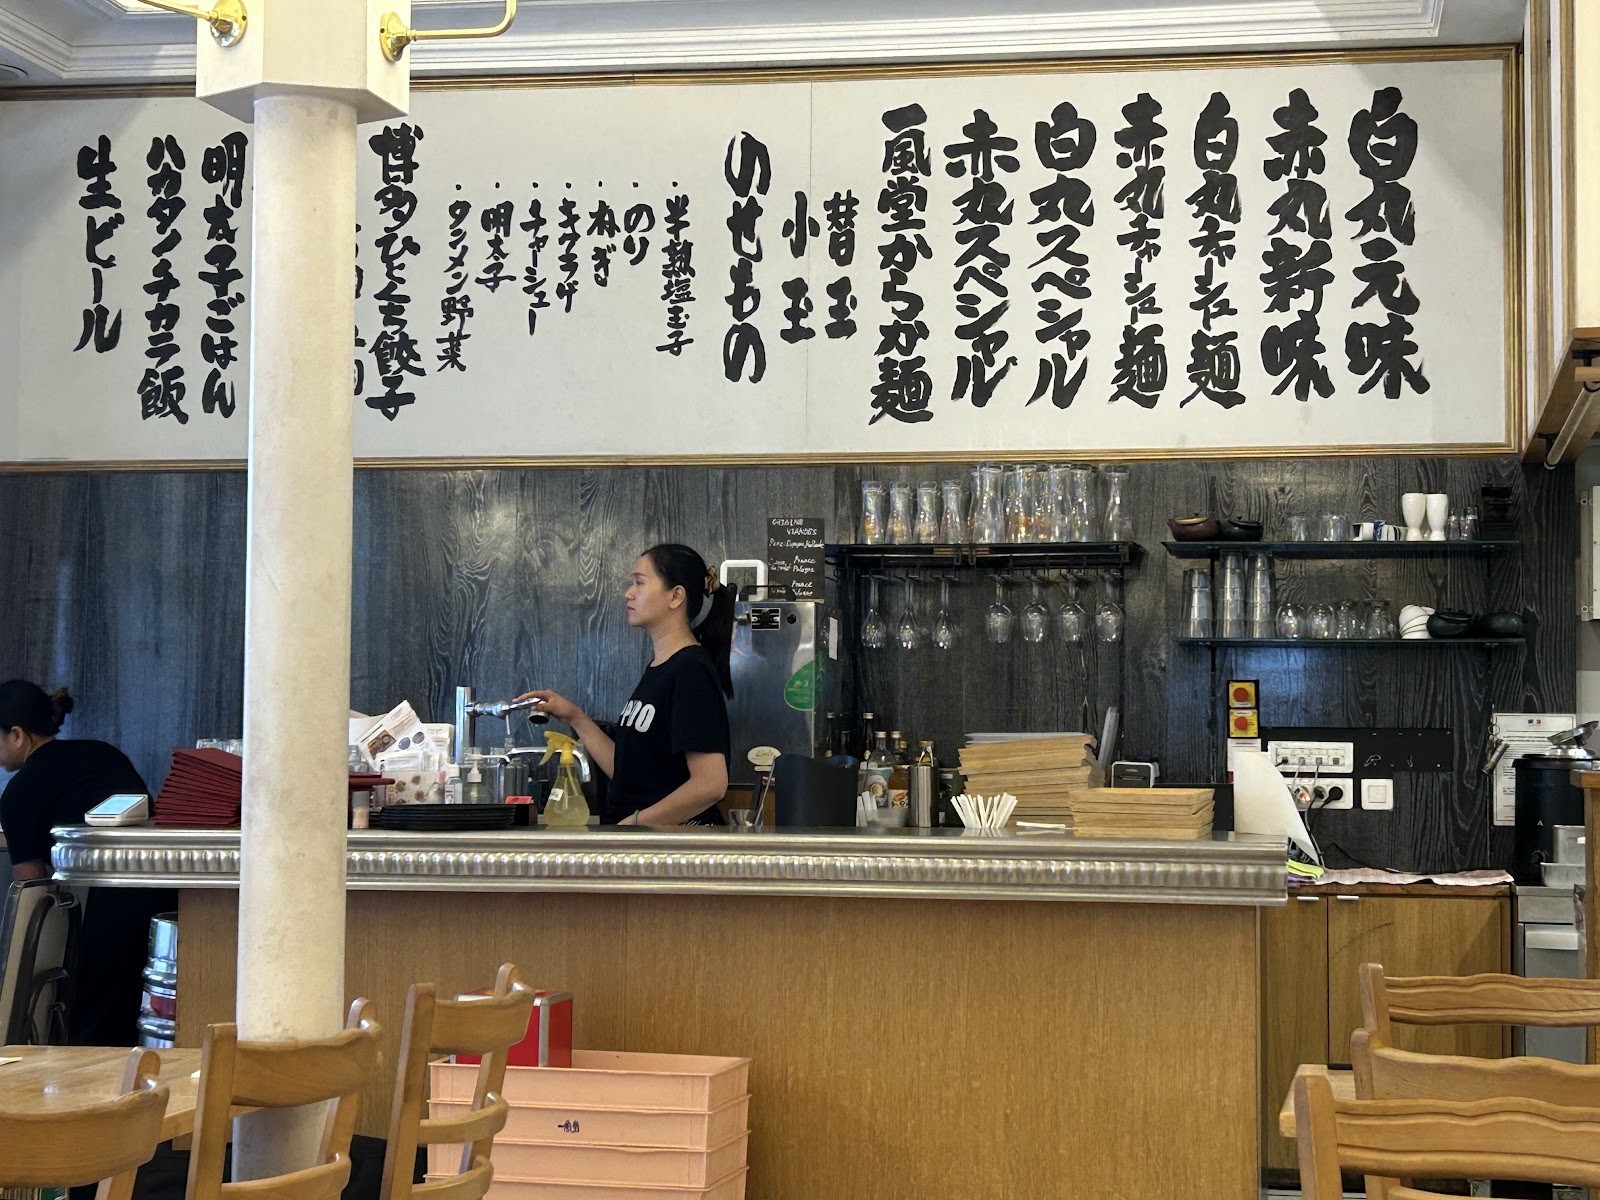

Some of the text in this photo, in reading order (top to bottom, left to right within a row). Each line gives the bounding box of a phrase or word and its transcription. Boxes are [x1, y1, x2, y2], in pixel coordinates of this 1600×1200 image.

[73, 135, 125, 353] 生ビール
[137, 135, 189, 424] ハカタノチカラ飯
[198, 131, 248, 418] 明太子ごはん
[365, 123, 426, 421] 博多ひとくち餃子
[723, 131, 771, 383] のせもの
[780, 191, 820, 344] 小玉
[943, 109, 1020, 408] 赤丸スペシャル
[1025, 102, 1097, 409] 白丸スペシャル
[1108, 93, 1168, 409] 赤丸チャーシュー麺
[1180, 91, 1247, 409] 白丸チャーシュー麺
[1260, 87, 1336, 402] 赤丸新味
[1345, 87, 1431, 399] 白丸元味
